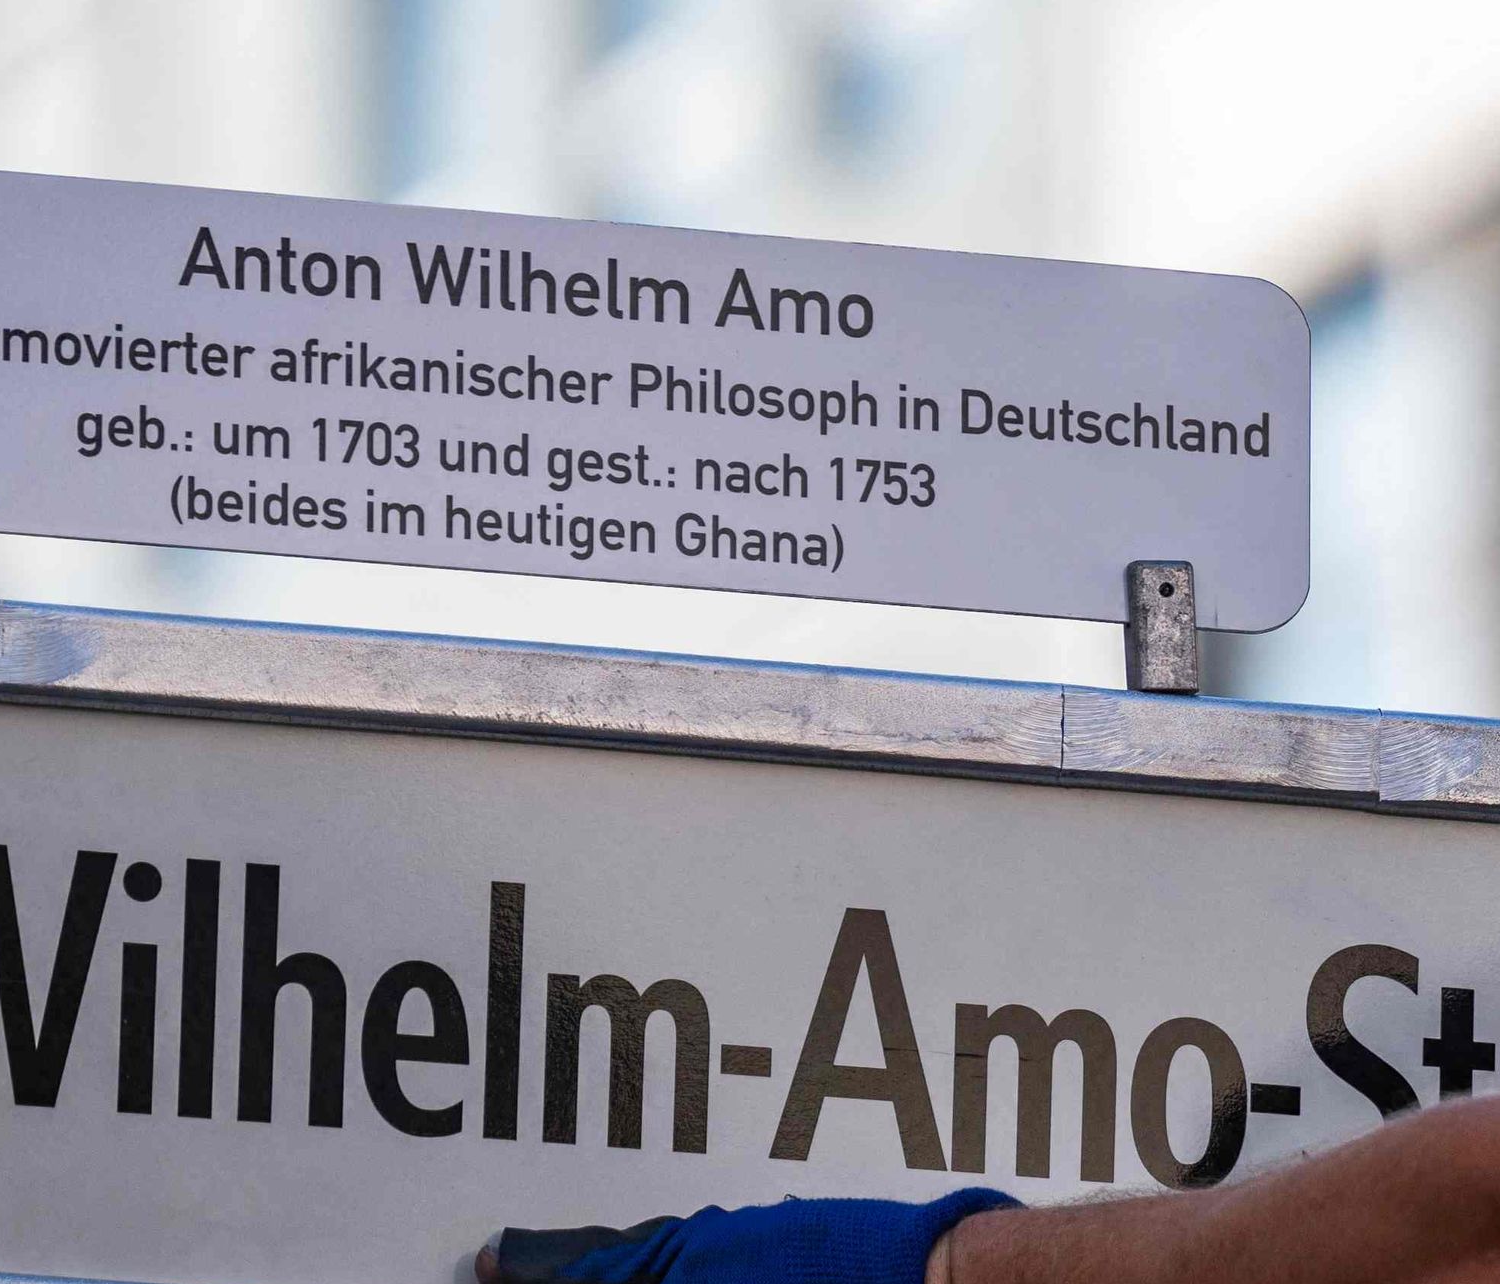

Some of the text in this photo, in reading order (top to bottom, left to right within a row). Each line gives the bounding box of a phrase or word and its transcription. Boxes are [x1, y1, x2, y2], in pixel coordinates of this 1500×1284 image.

[177, 225, 875, 340] Anton Wilhelm Amo
[269, 337, 614, 407] afrikanischer
[629, 361, 879, 437] Philosoph
[898, 382, 941, 433] in
[960, 387, 1271, 459] Deutschland
[75, 403, 937, 509] geb.: um 1703 und gest.: nach 1753
[169, 474, 845, 574] (beides im heutigen Ghana)
